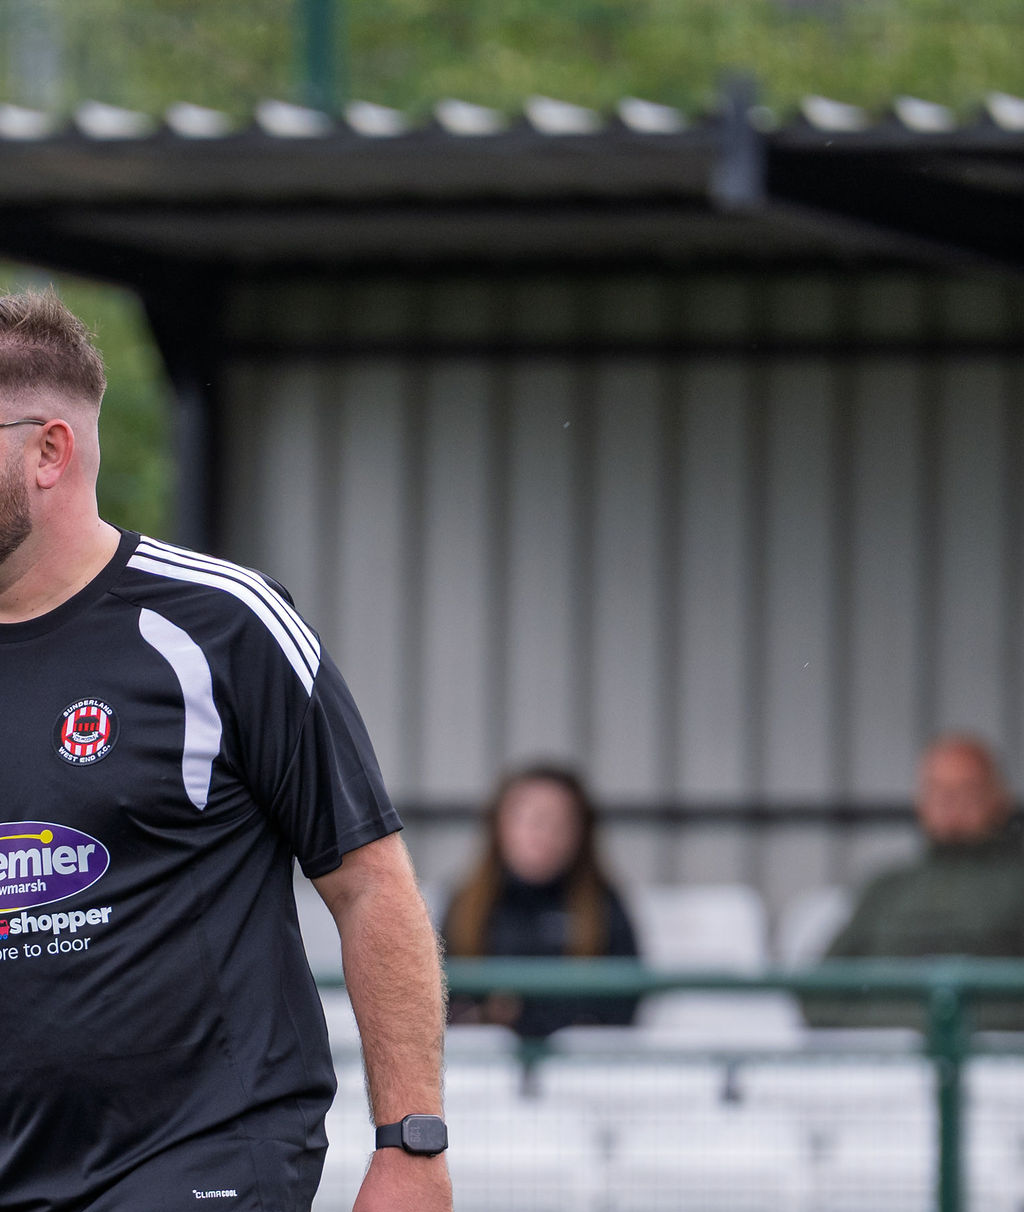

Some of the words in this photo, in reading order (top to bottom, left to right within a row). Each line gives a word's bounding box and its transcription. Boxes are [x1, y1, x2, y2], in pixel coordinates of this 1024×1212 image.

[63, 700, 113, 717] SUNDERLAND
[58, 746, 78, 762] WEST
[79, 755, 96, 763] END
[97, 744, 111, 757] F.C.
[9, 905, 112, 935] shopper
[23, 942, 43, 958] to
[47, 936, 91, 955] door
